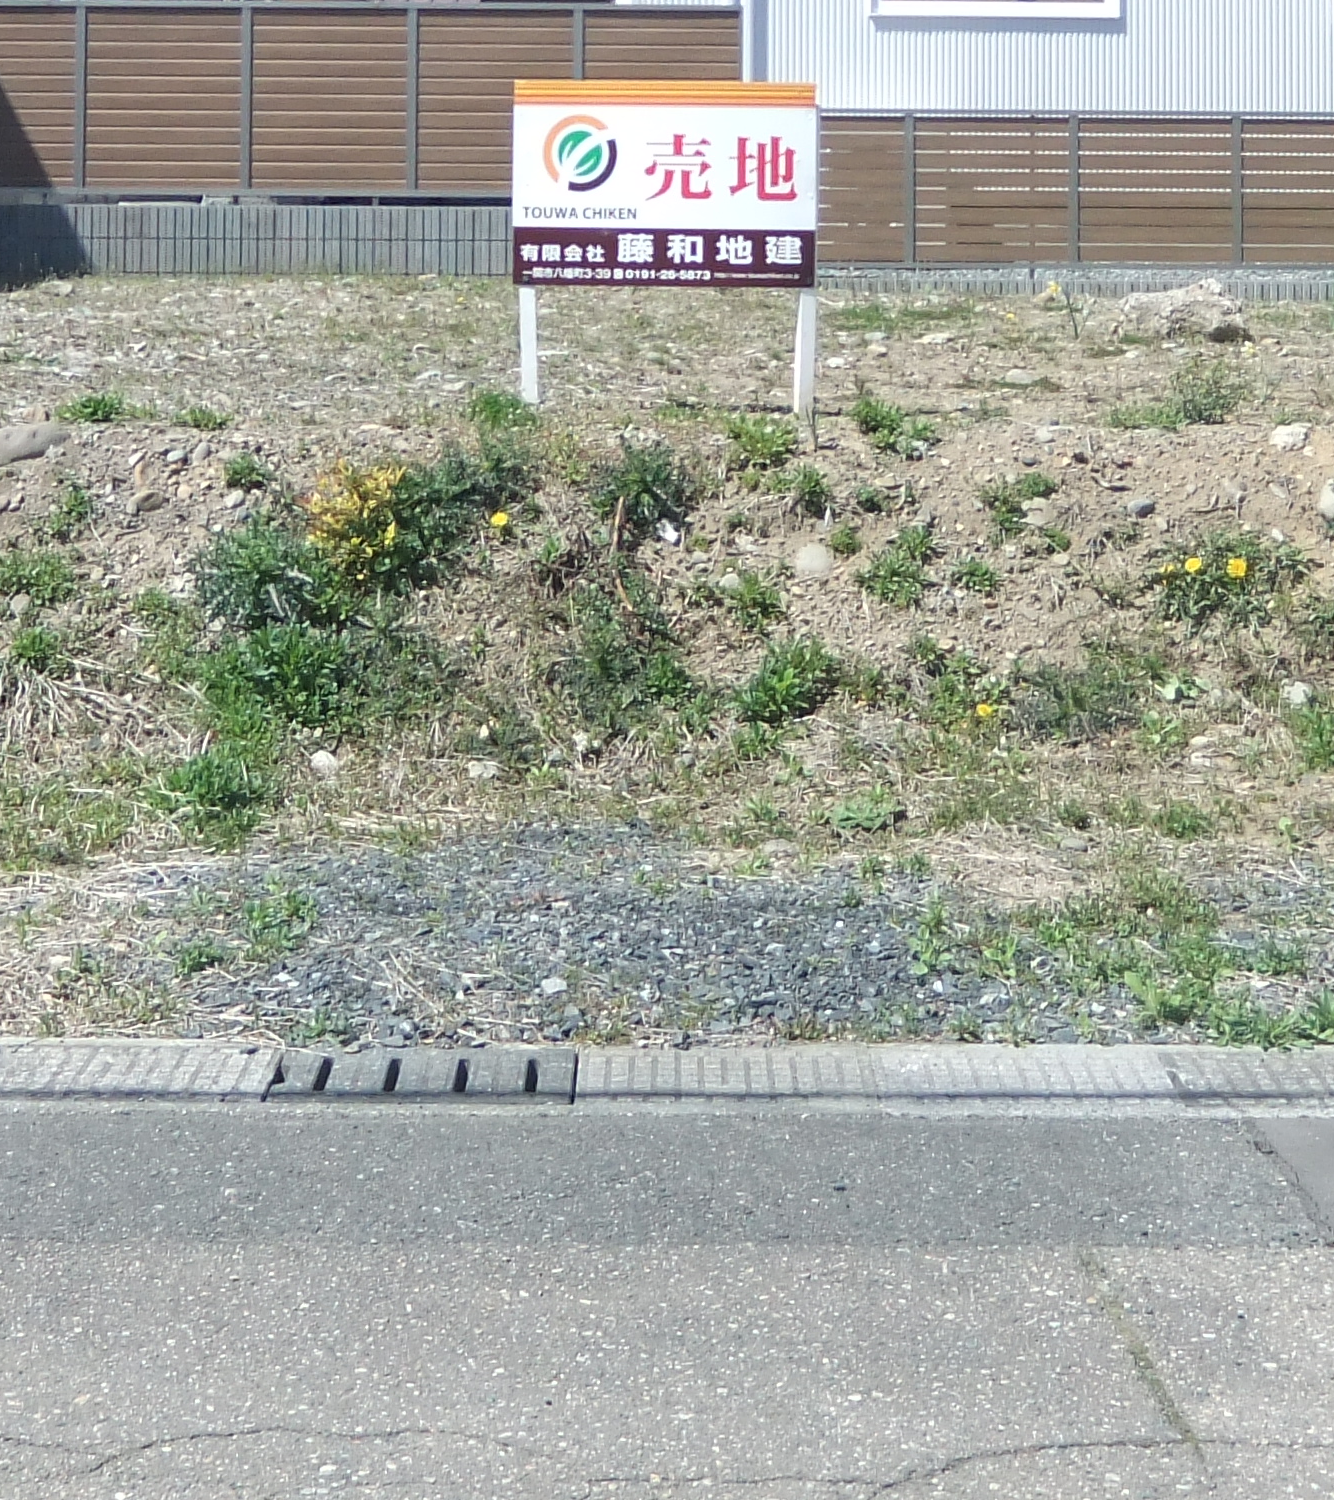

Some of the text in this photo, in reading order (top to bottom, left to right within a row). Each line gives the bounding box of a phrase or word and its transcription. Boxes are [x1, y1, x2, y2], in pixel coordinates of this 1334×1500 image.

[643, 133, 798, 201] 売地
[522, 206, 637, 220] TOUWA CHIKEN
[520, 233, 802, 265] 有限会社 藤和地建
